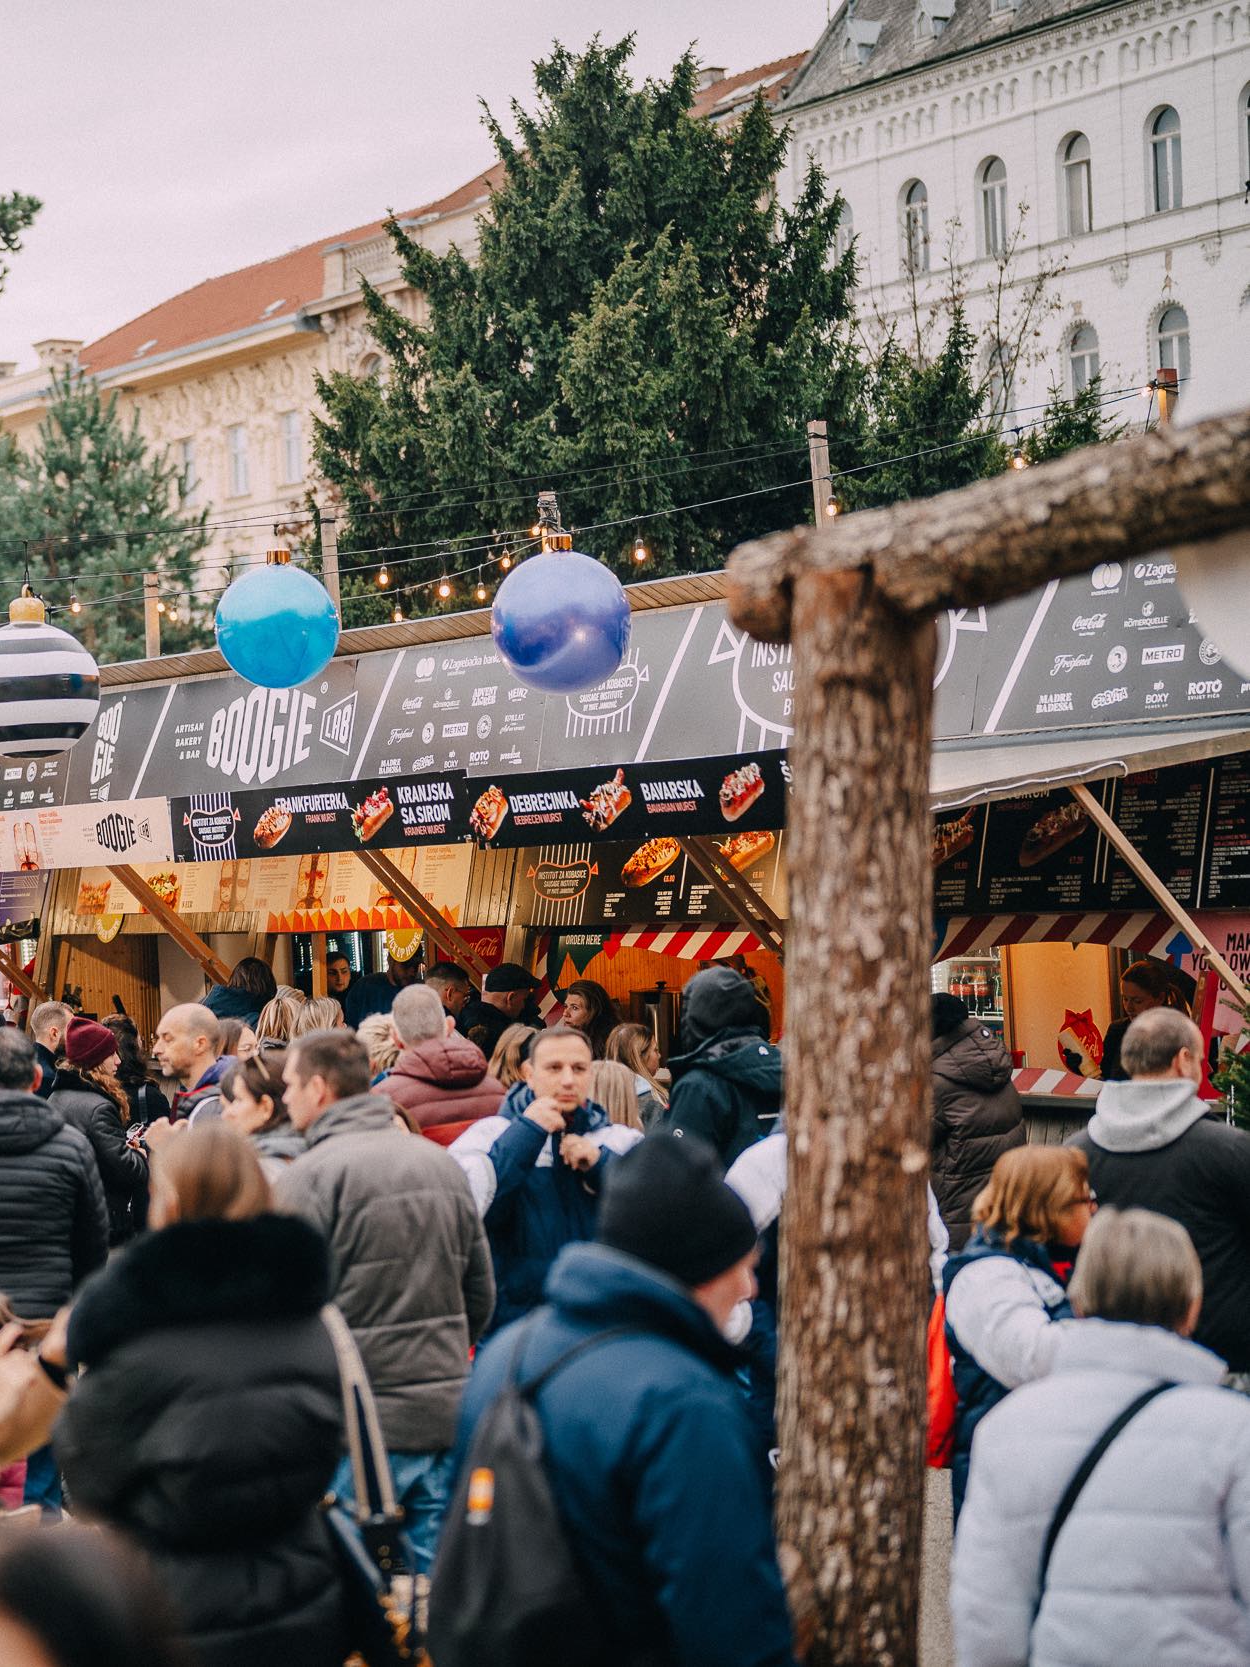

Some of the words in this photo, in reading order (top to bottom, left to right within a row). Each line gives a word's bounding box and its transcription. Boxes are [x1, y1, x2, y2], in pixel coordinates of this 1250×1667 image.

[1145, 648, 1181, 660] METRO
[607, 677, 634, 690] KOBASICE
[508, 688, 528, 700] HEINZ
[1039, 693, 1072, 704] MADRE
[1145, 693, 1169, 704] BOXY
[1036, 702, 1074, 713] BADESSA
[97, 701, 123, 745] BOO
[175, 722, 204, 734] ARTISAN
[206, 686, 317, 784] BOOGIE
[324, 703, 354, 744] LAB
[445, 726, 466, 734] METRO
[175, 736, 202, 747] BAKERY
[91, 739, 116, 784] GIE
[179, 751, 184, 760] &
[186, 750, 200, 759] BAR
[470, 750, 490, 762] ROTO
[397, 782, 454, 804] KRANJSKA
[640, 779, 705, 801] BAVARSKA
[275, 792, 350, 813] FRANKFURTERKA
[509, 791, 580, 813] DEBRECINKA
[646, 803, 677, 814] BAVARIAN
[676, 801, 698, 812] WURST
[400, 807, 417, 824] SA
[417, 803, 451, 823] SIROM
[513, 814, 543, 826] DEBRECEN
[543, 812, 563, 823] WURST
[96, 813, 137, 852] BOOGIE
[404, 826, 427, 836] KRAINER
[427, 824, 446, 834] WURST
[538, 871, 559, 880] INSTITUT
[559, 871, 565, 880] ZA
[565, 870, 587, 879] KOBASICE
[388, 932, 397, 953] PICK
[396, 948, 406, 958] UP
[405, 932, 421, 955] HERE
[566, 934, 585, 945] ORDER
[586, 934, 602, 945] HERE
[1230, 953, 1250, 971] OW
